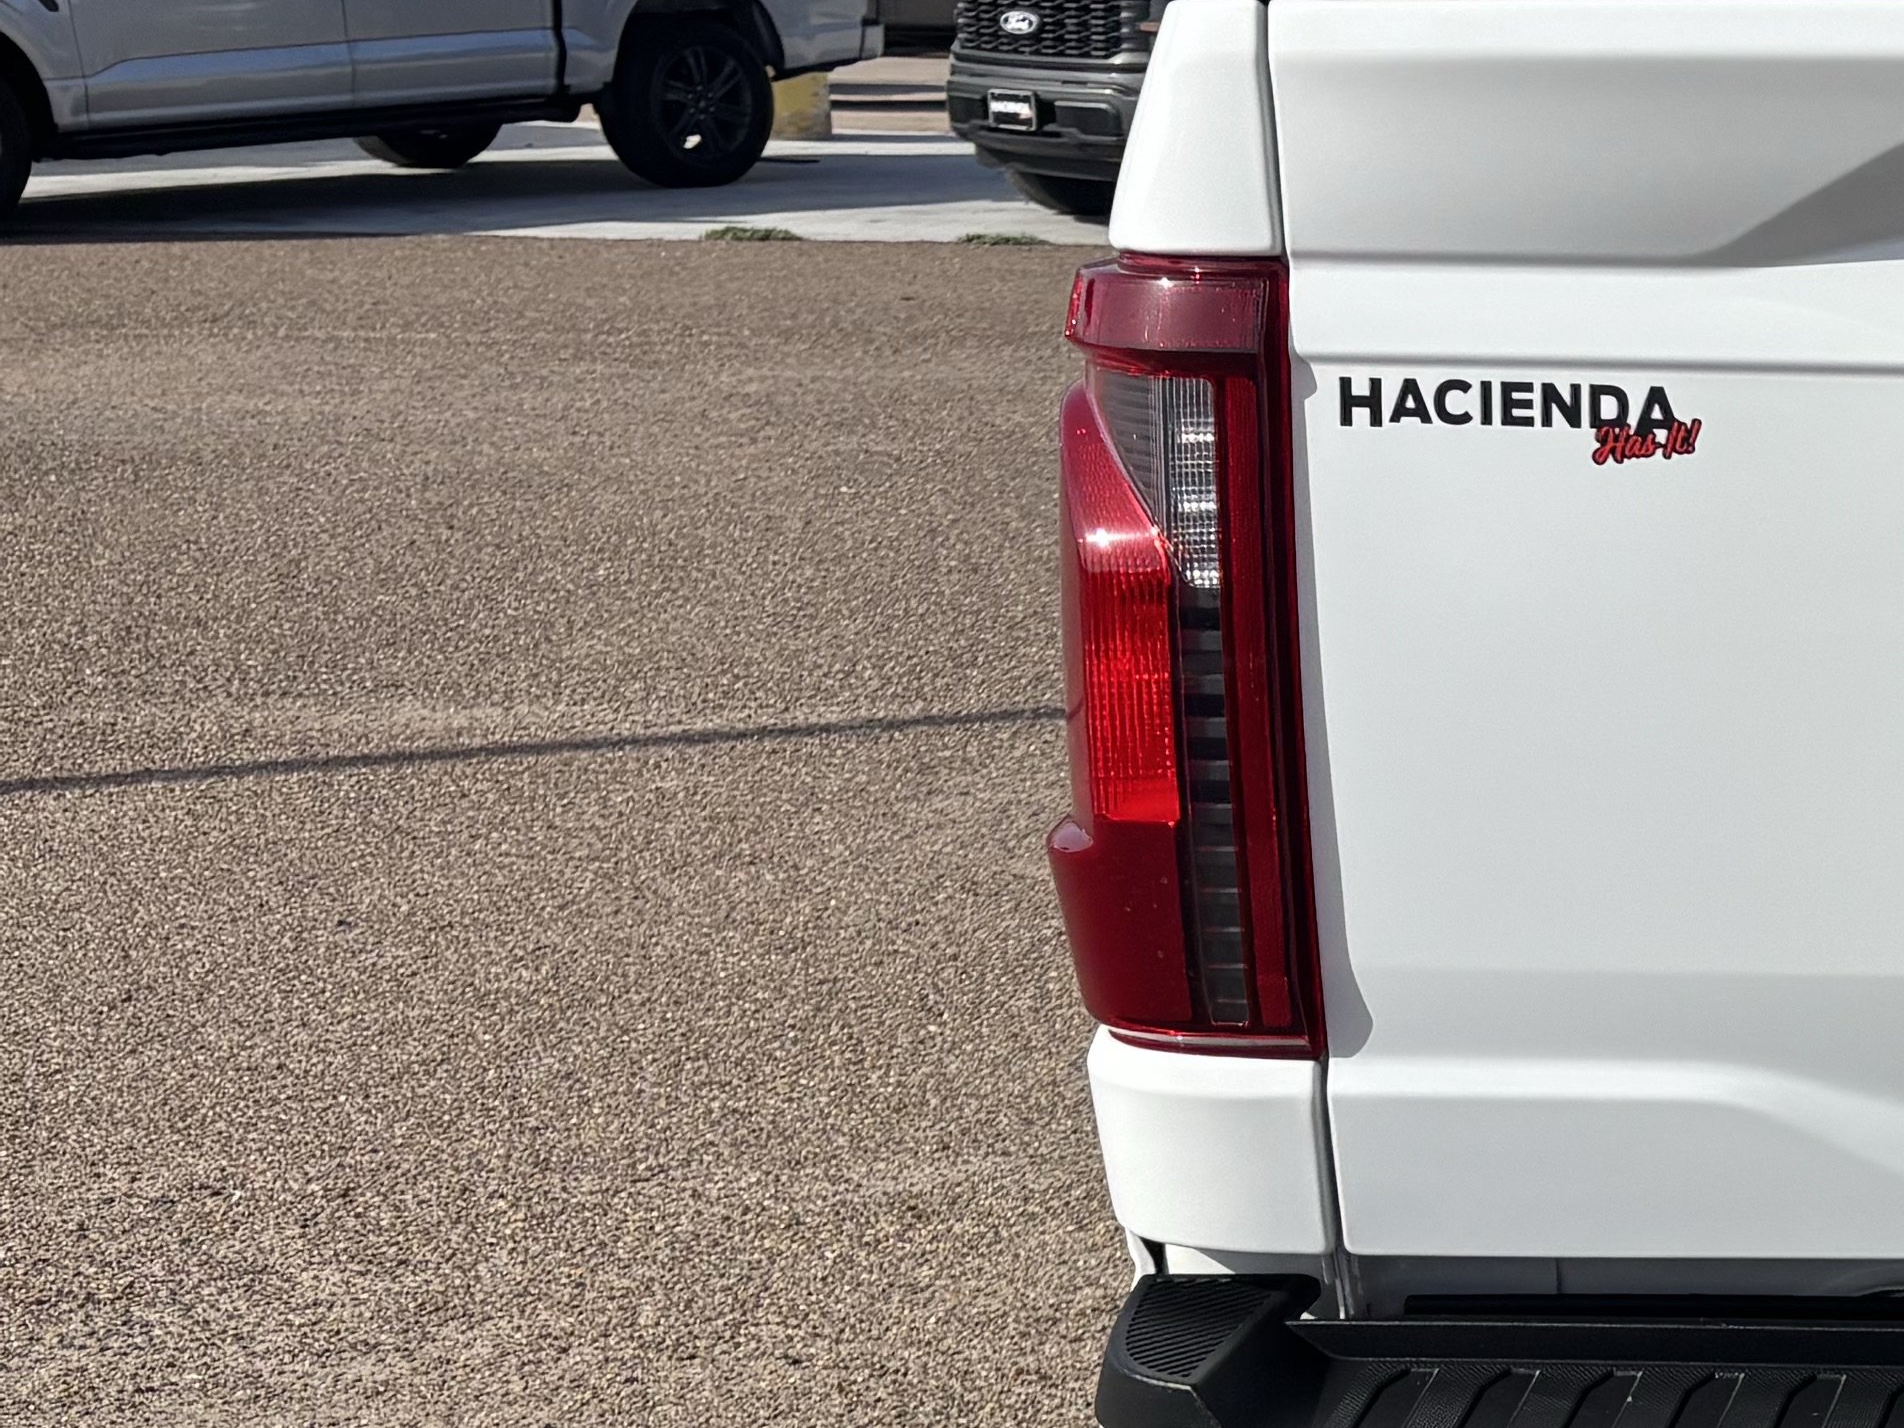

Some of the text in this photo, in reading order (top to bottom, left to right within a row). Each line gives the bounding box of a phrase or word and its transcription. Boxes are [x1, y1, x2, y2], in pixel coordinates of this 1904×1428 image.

[1338, 375, 1678, 436] HACIENDA
[1592, 418, 1702, 465] Has It!
